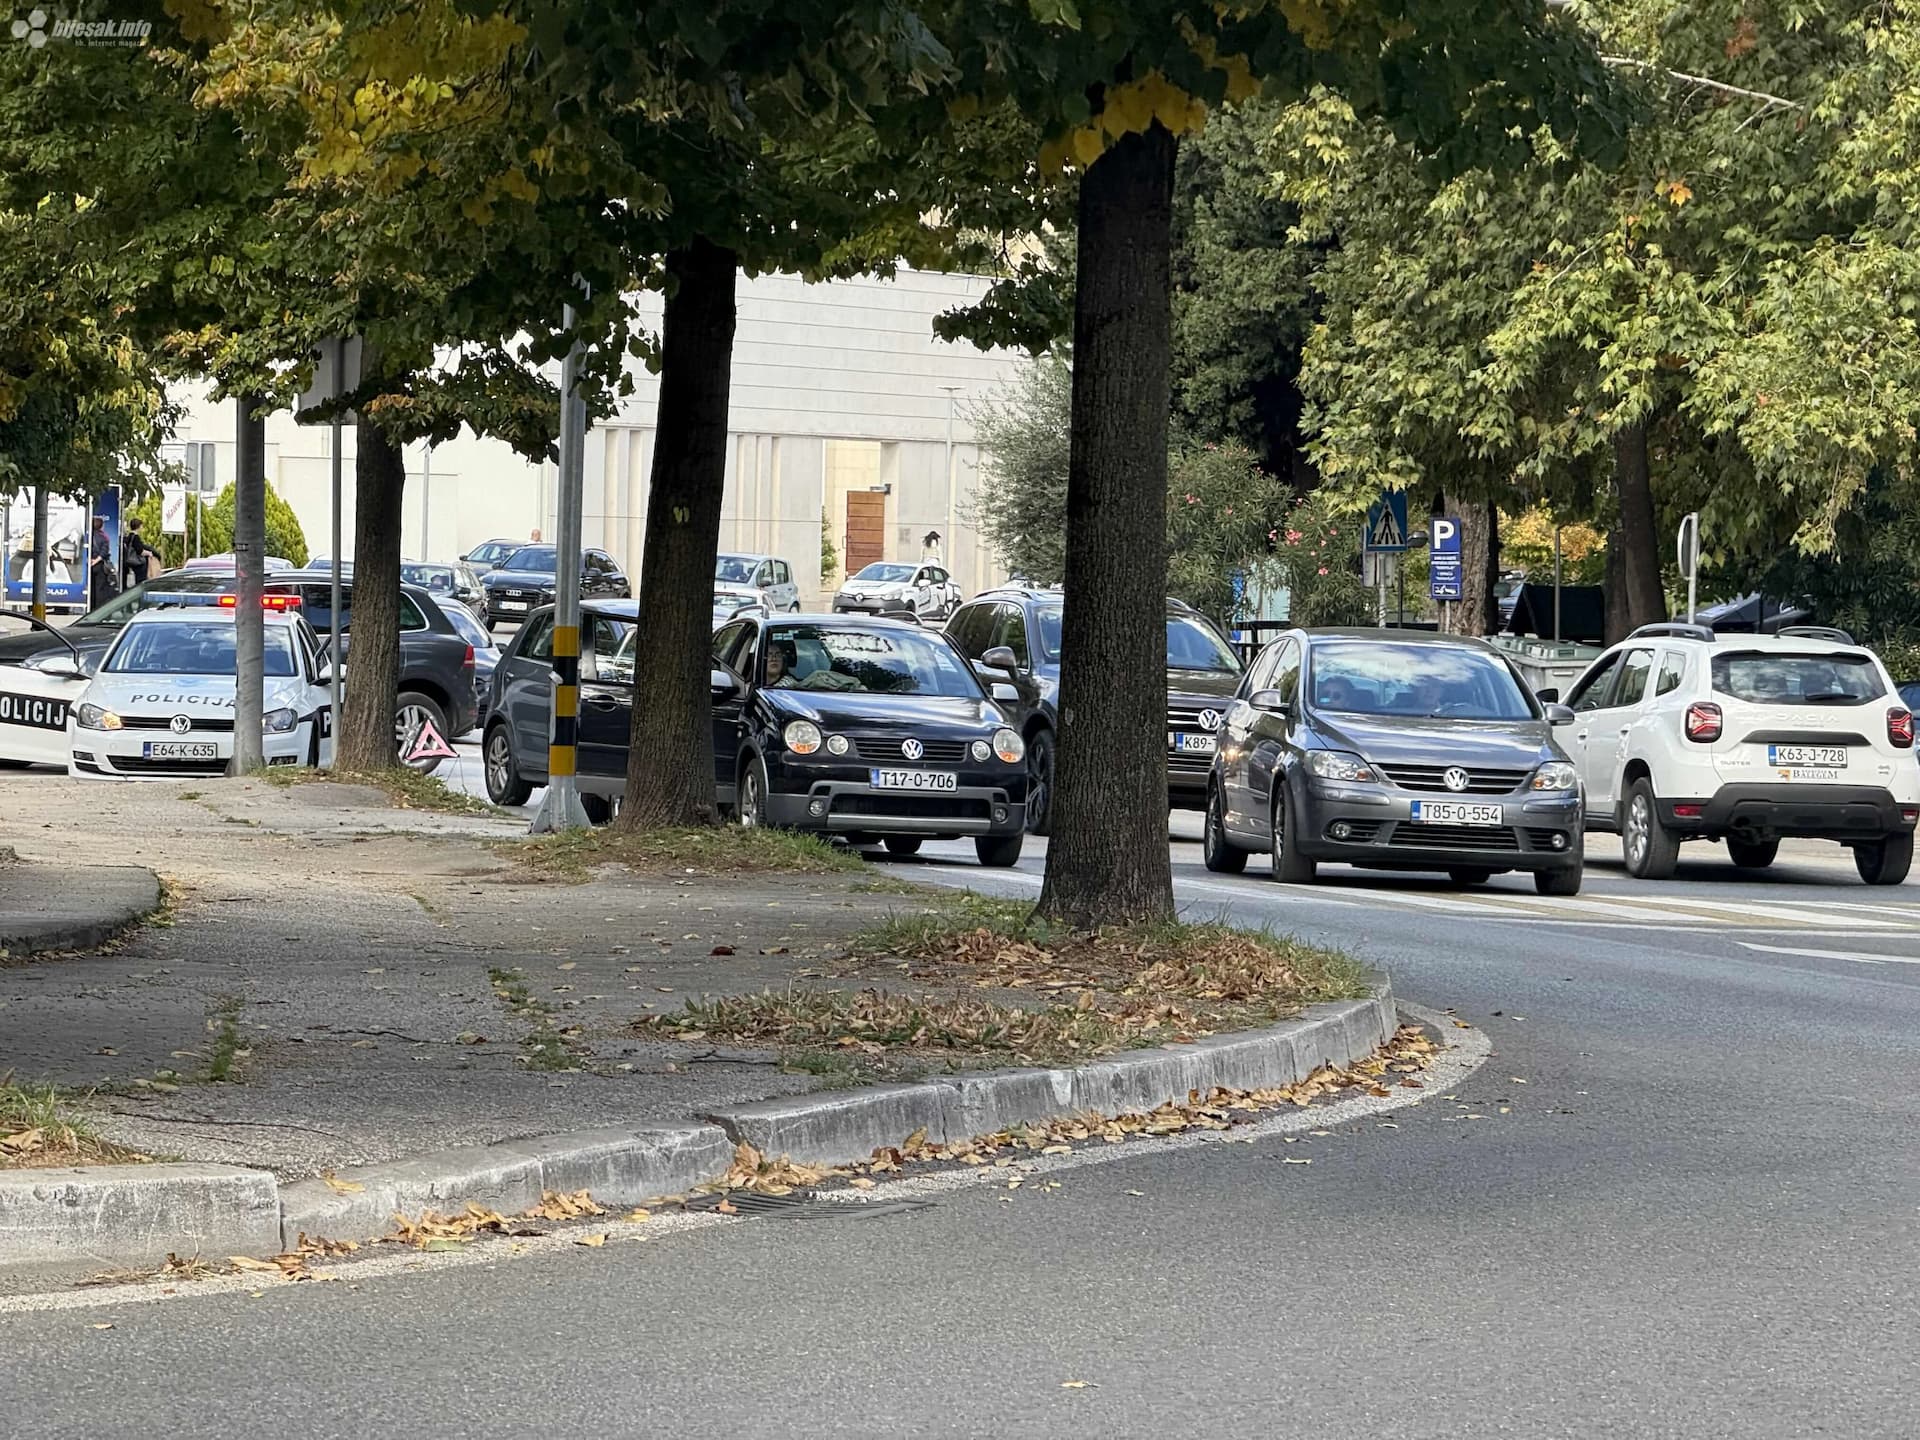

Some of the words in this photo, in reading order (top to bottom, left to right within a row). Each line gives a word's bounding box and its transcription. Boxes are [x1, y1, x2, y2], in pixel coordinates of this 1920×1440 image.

[1434, 520, 1455, 549] P
[131, 694, 235, 708] POLICIJA
[0, 696, 65, 726] OLICIJ
[153, 744, 214, 757] E64-K-635
[1778, 747, 1844, 762] K63-J-728
